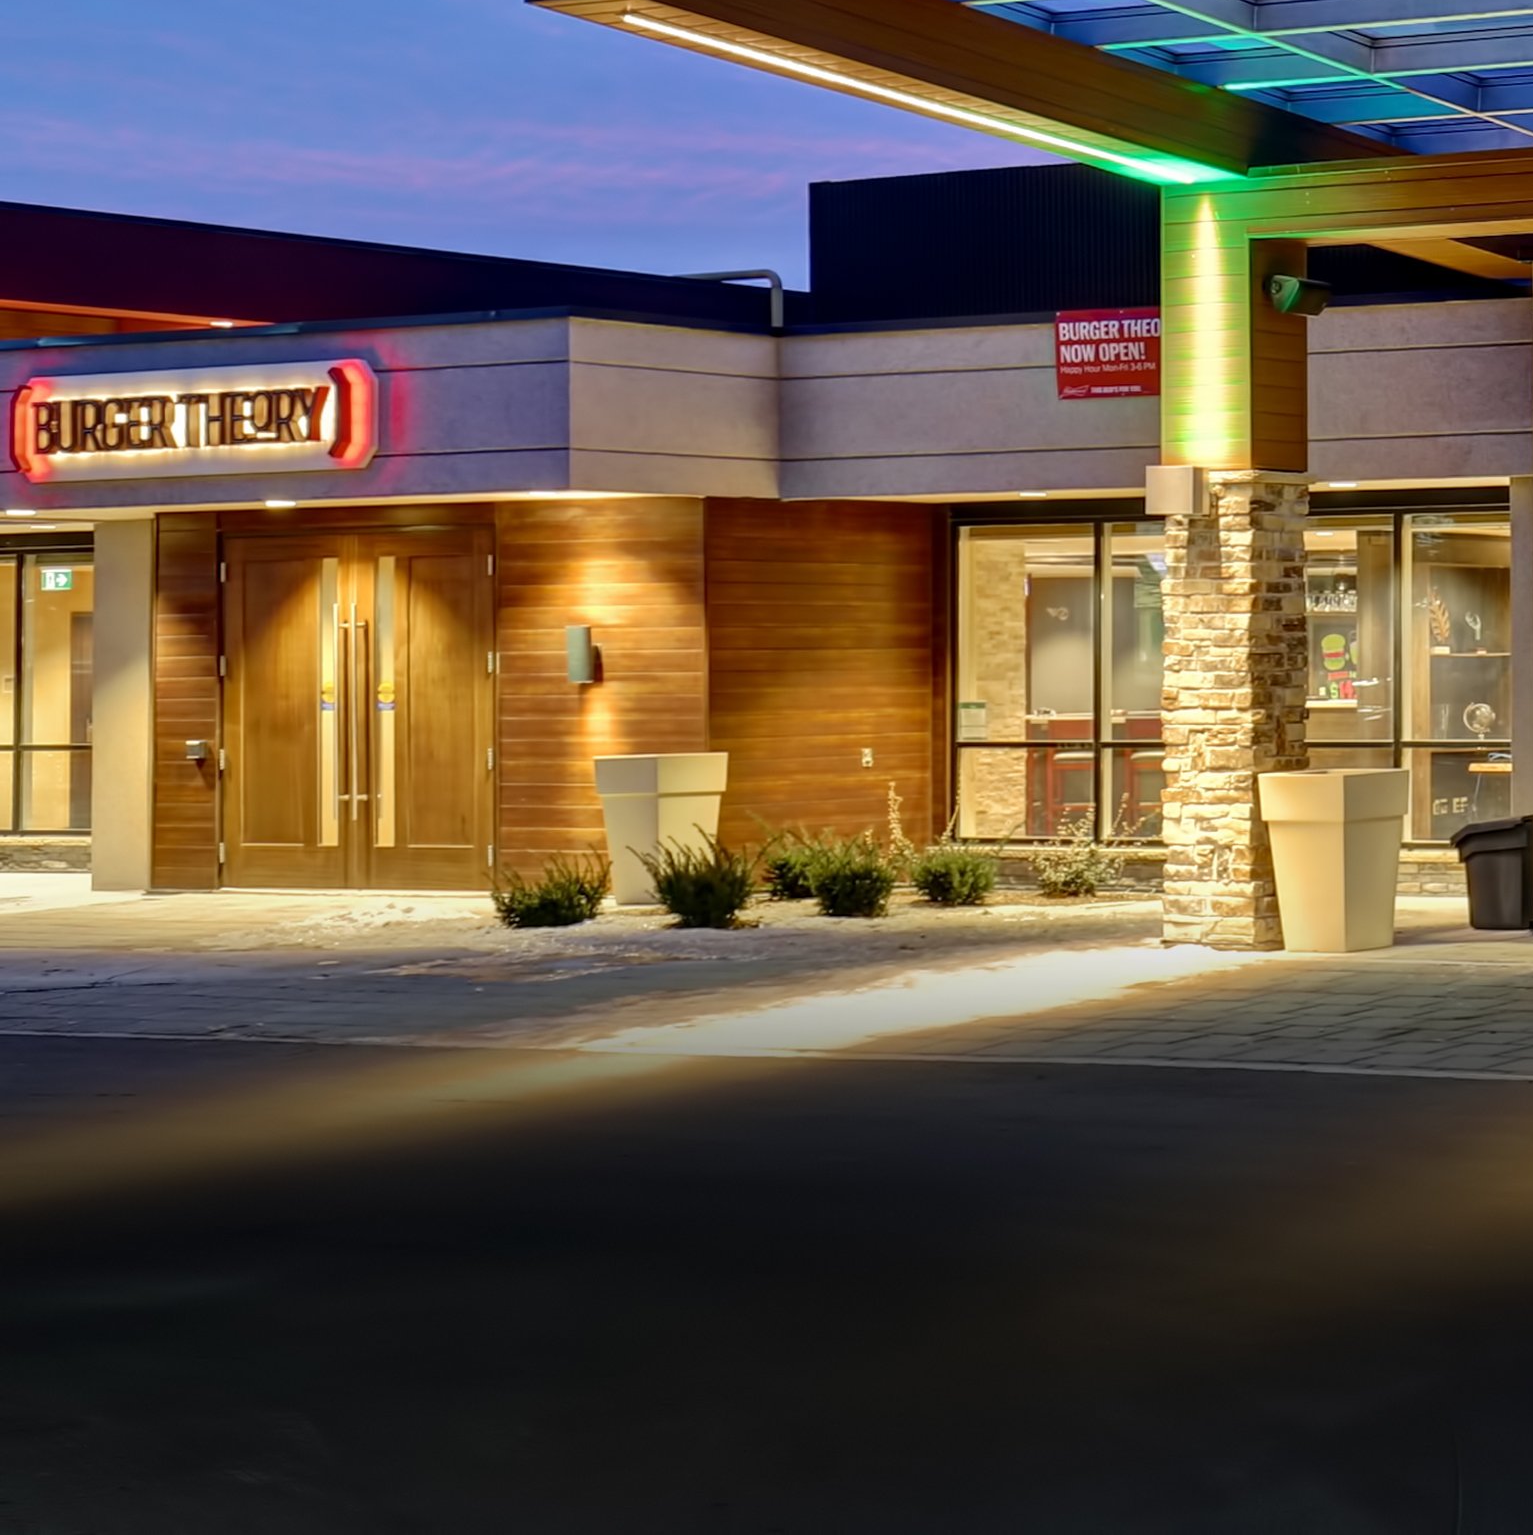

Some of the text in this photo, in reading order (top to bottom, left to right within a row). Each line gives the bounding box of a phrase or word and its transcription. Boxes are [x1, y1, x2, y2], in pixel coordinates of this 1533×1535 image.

[1059, 321, 1119, 341] BURGER
[1061, 343, 1145, 363] NOW OPEN!
[33, 386, 330, 455] BURGER THEORY
